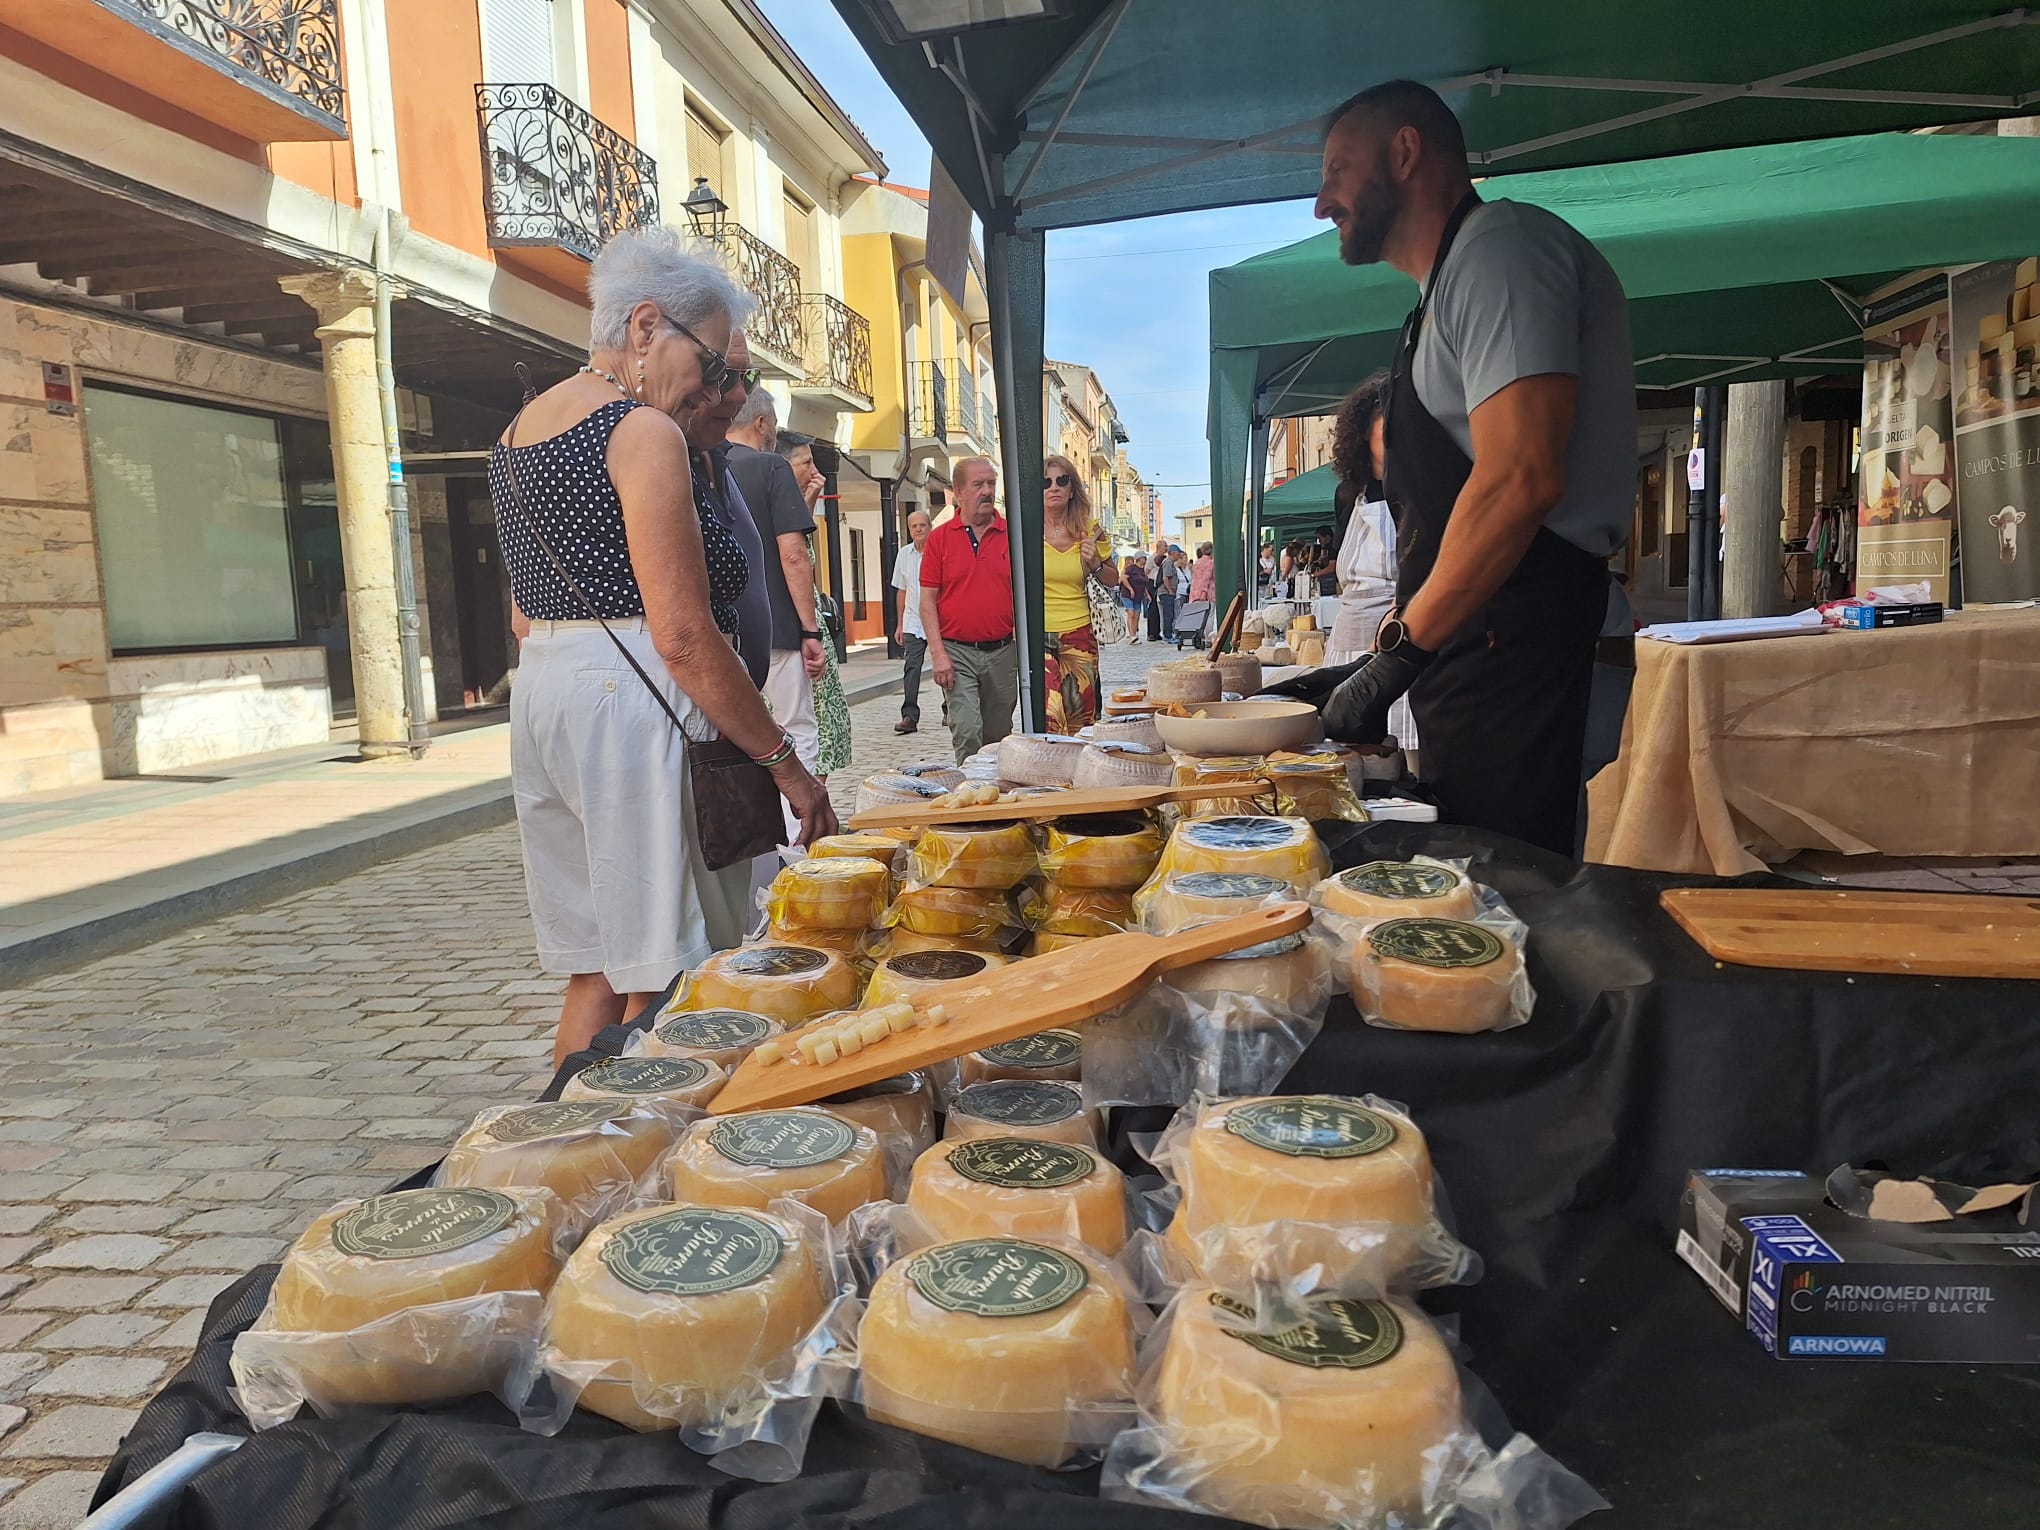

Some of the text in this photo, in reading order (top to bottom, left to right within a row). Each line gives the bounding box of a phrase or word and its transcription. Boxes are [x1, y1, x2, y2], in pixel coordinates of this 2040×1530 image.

[1885, 428, 1912, 443] ORIGEN
[1965, 454, 2007, 478] CAMPOS
[2009, 450, 2023, 469] DE
[1862, 551, 1938, 567] CAMPOS DE LUNA
[760, 1118, 808, 1155] Barros
[795, 1126, 837, 1155] Curado
[994, 1145, 1048, 1176] Barros
[1027, 1155, 1078, 1180] Curado
[381, 1194, 466, 1243] Barros
[420, 1204, 495, 1243] Curado
[663, 1221, 723, 1276] Barros
[705, 1233, 759, 1276] Curado
[1777, 1244, 1829, 1257] XL
[967, 1248, 1028, 1298] Barros
[1009, 1261, 1064, 1300] Curado
[1754, 1250, 1776, 1290] XL
[1824, 1301, 1987, 1313] MIDNIGHT BLACK
[1825, 1285, 1995, 1302] ARNOMED NITRIL
[1789, 1338, 1884, 1353] ARNOWA
